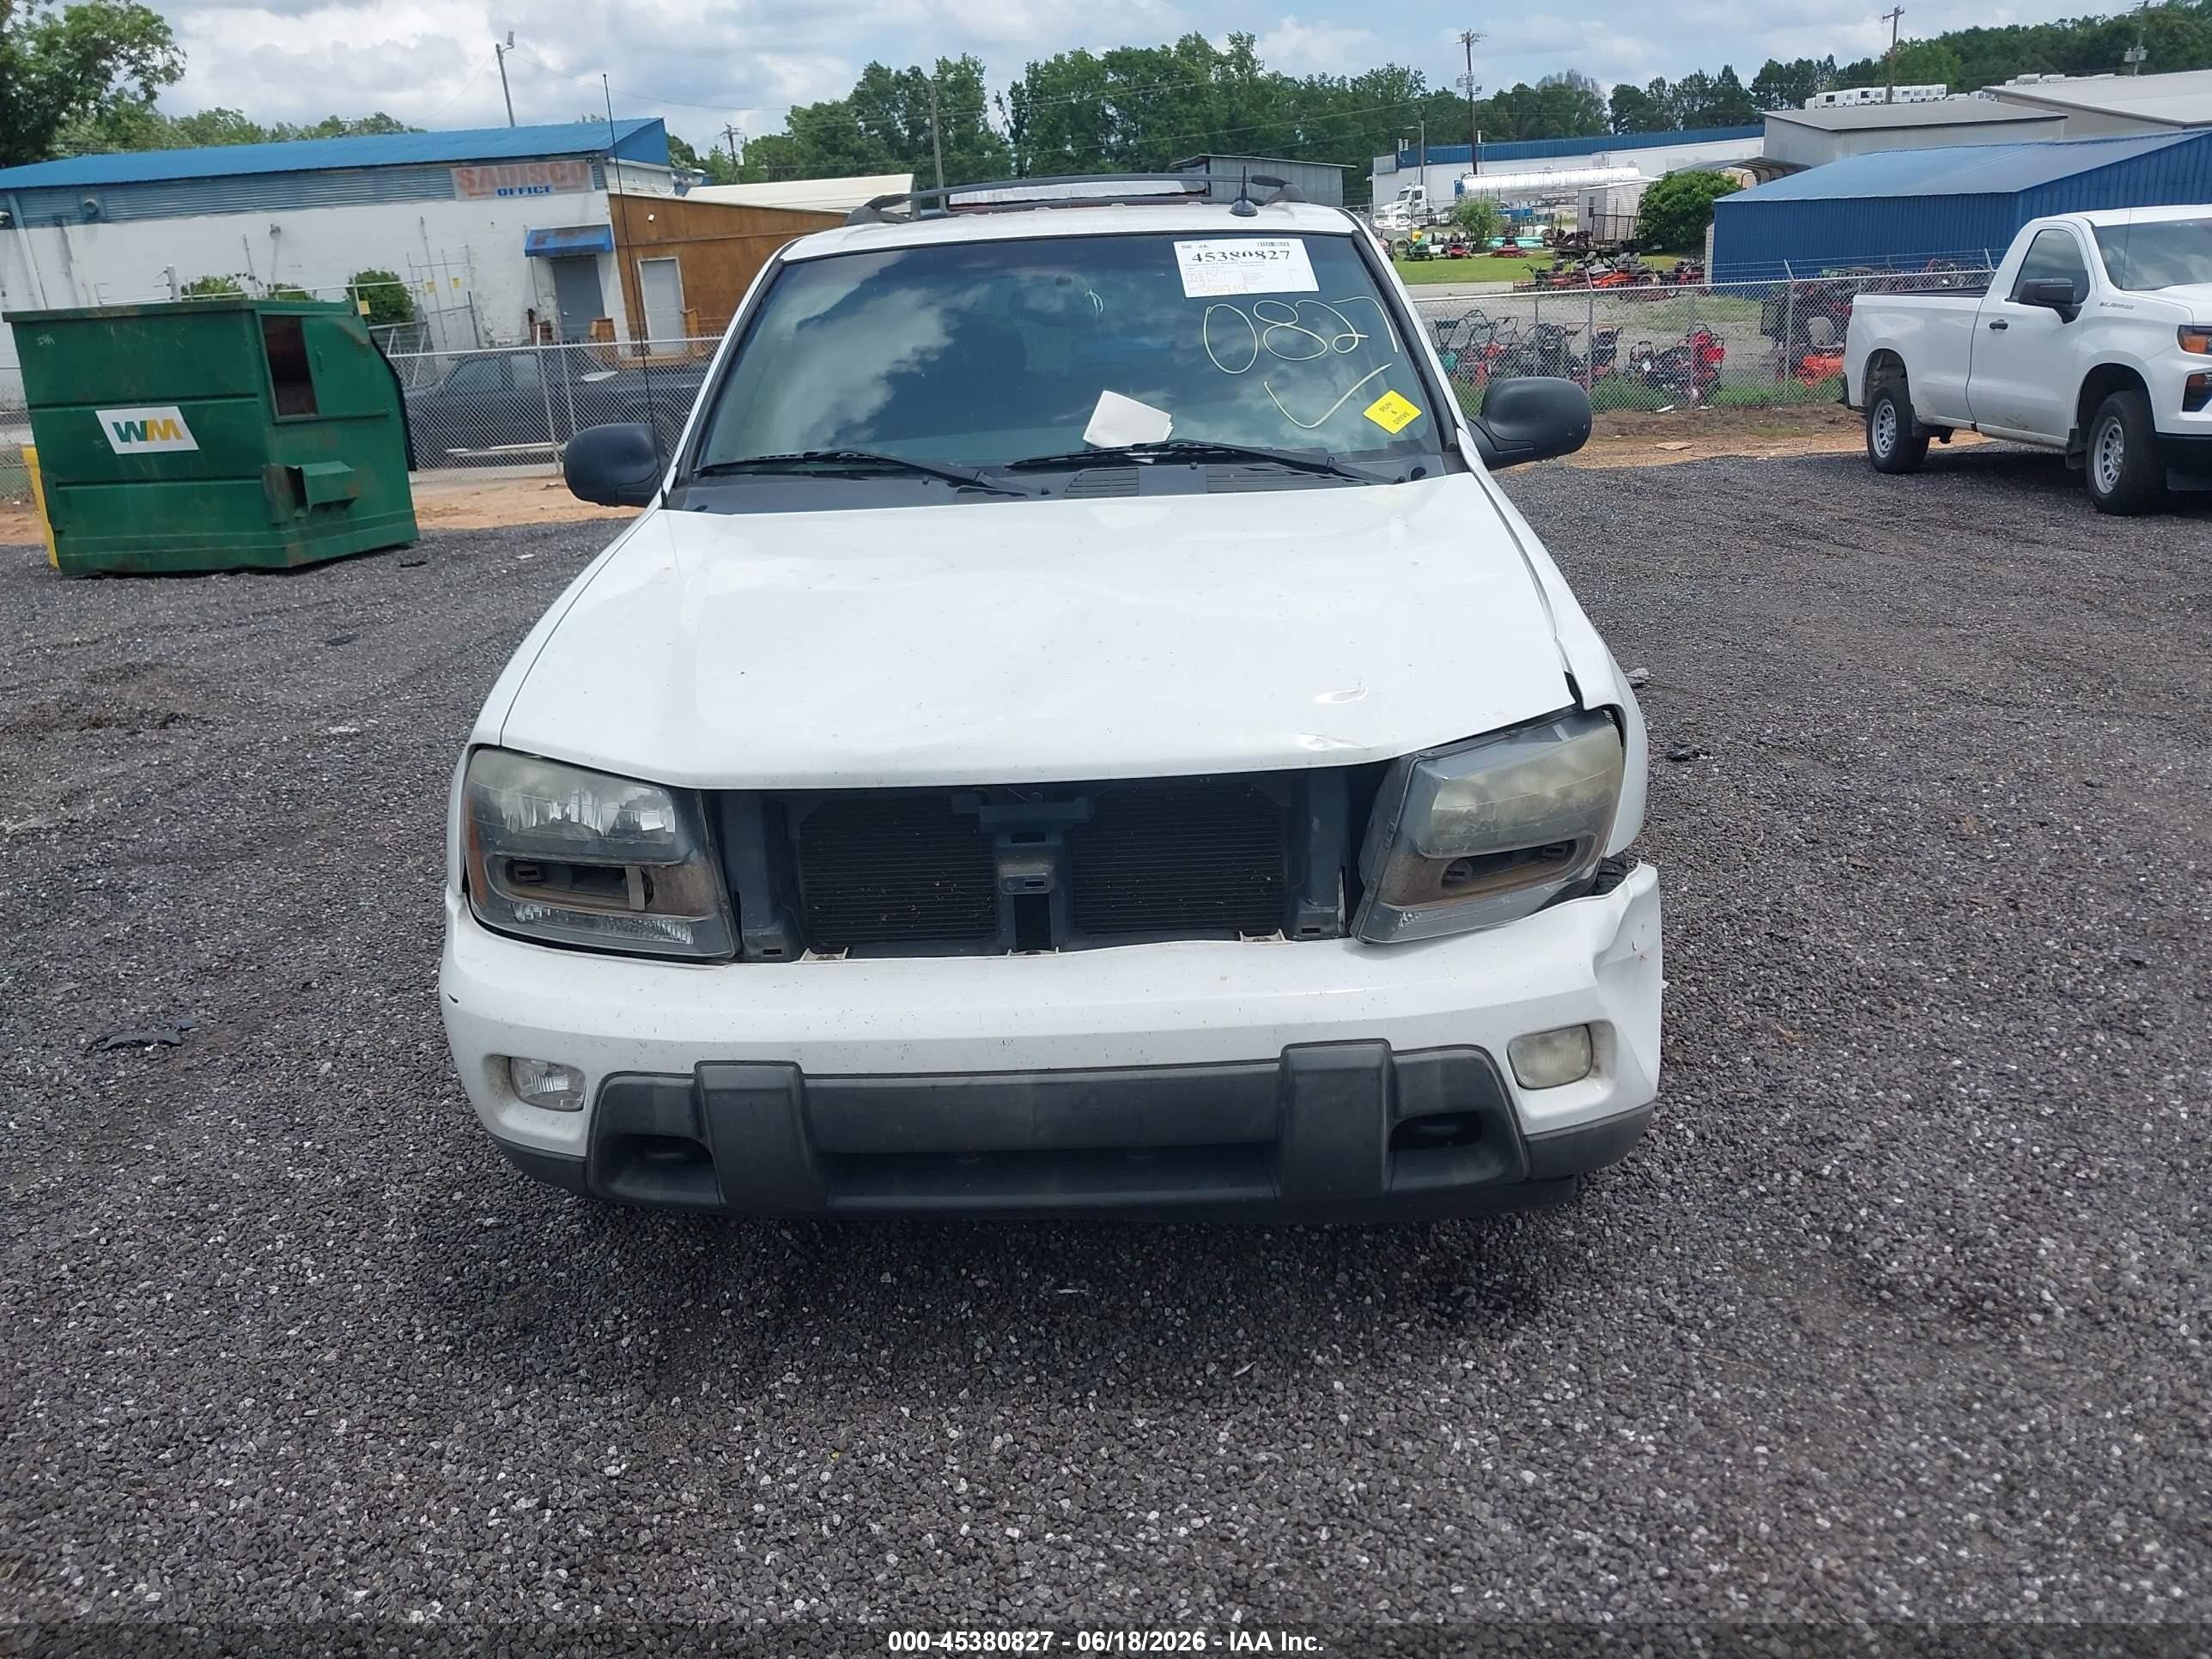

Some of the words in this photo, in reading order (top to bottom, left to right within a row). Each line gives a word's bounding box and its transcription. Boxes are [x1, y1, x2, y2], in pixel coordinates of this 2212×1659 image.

[457, 161, 587, 189] SADISCO
[496, 185, 554, 197] OFFICE
[1203, 295, 1399, 374] 0827
[1379, 401, 1394, 413] RUN
[1393, 410, 1411, 425] DRIVE
[111, 418, 184, 443] WM
